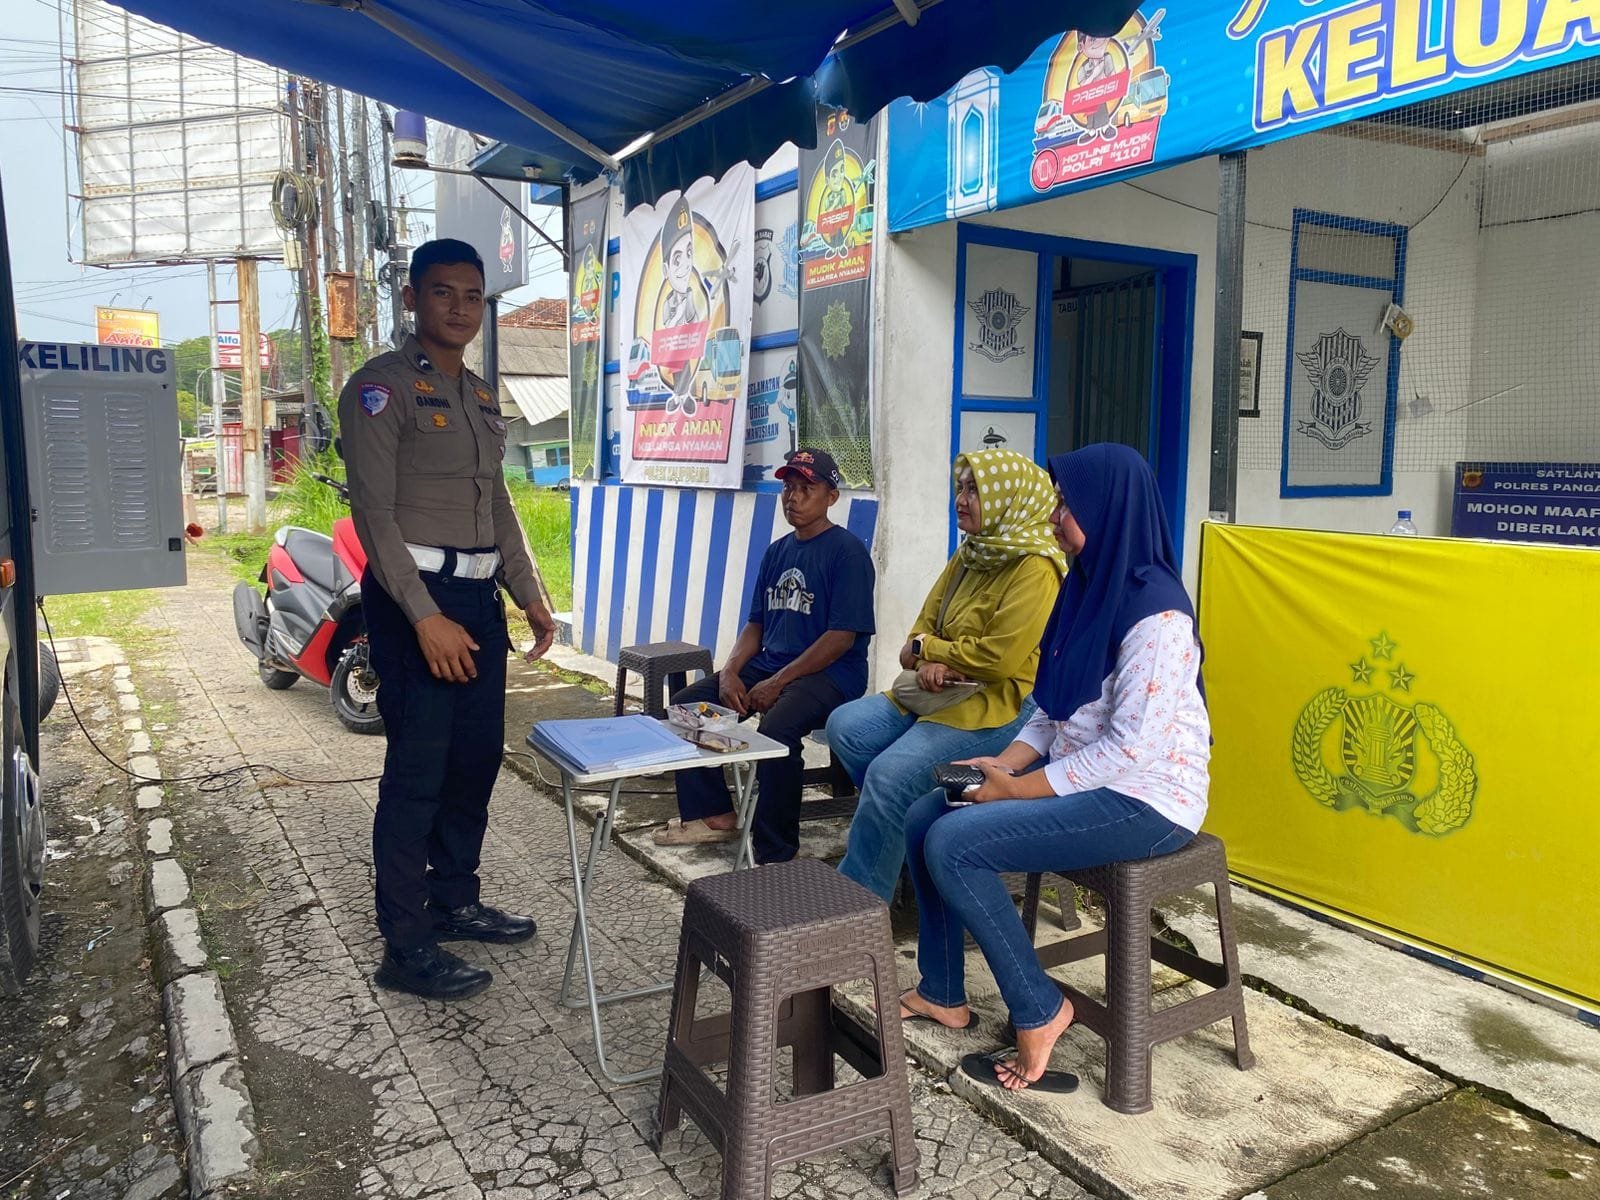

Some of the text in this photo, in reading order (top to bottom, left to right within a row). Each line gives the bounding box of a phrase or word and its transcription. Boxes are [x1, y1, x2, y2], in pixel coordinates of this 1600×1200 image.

[1072, 80, 1119, 106] PRESISI
[1062, 131, 1153, 163] HOTLINE MUDIK
[1062, 157, 1103, 176] POLRI
[809, 262, 836, 276] MUDIK
[839, 266, 866, 279] NYAMAN
[218, 335, 240, 345] Alfa
[18, 342, 167, 375] KELILING
[749, 400, 769, 419] Untuk
[639, 421, 677, 438] MUDIK
[638, 440, 723, 452] KELUARGA NYAMAN
[1494, 481, 1548, 491] POLRES
[1467, 503, 1600, 518] MOHON MAAF
[1497, 521, 1600, 537] DIBERLAK
